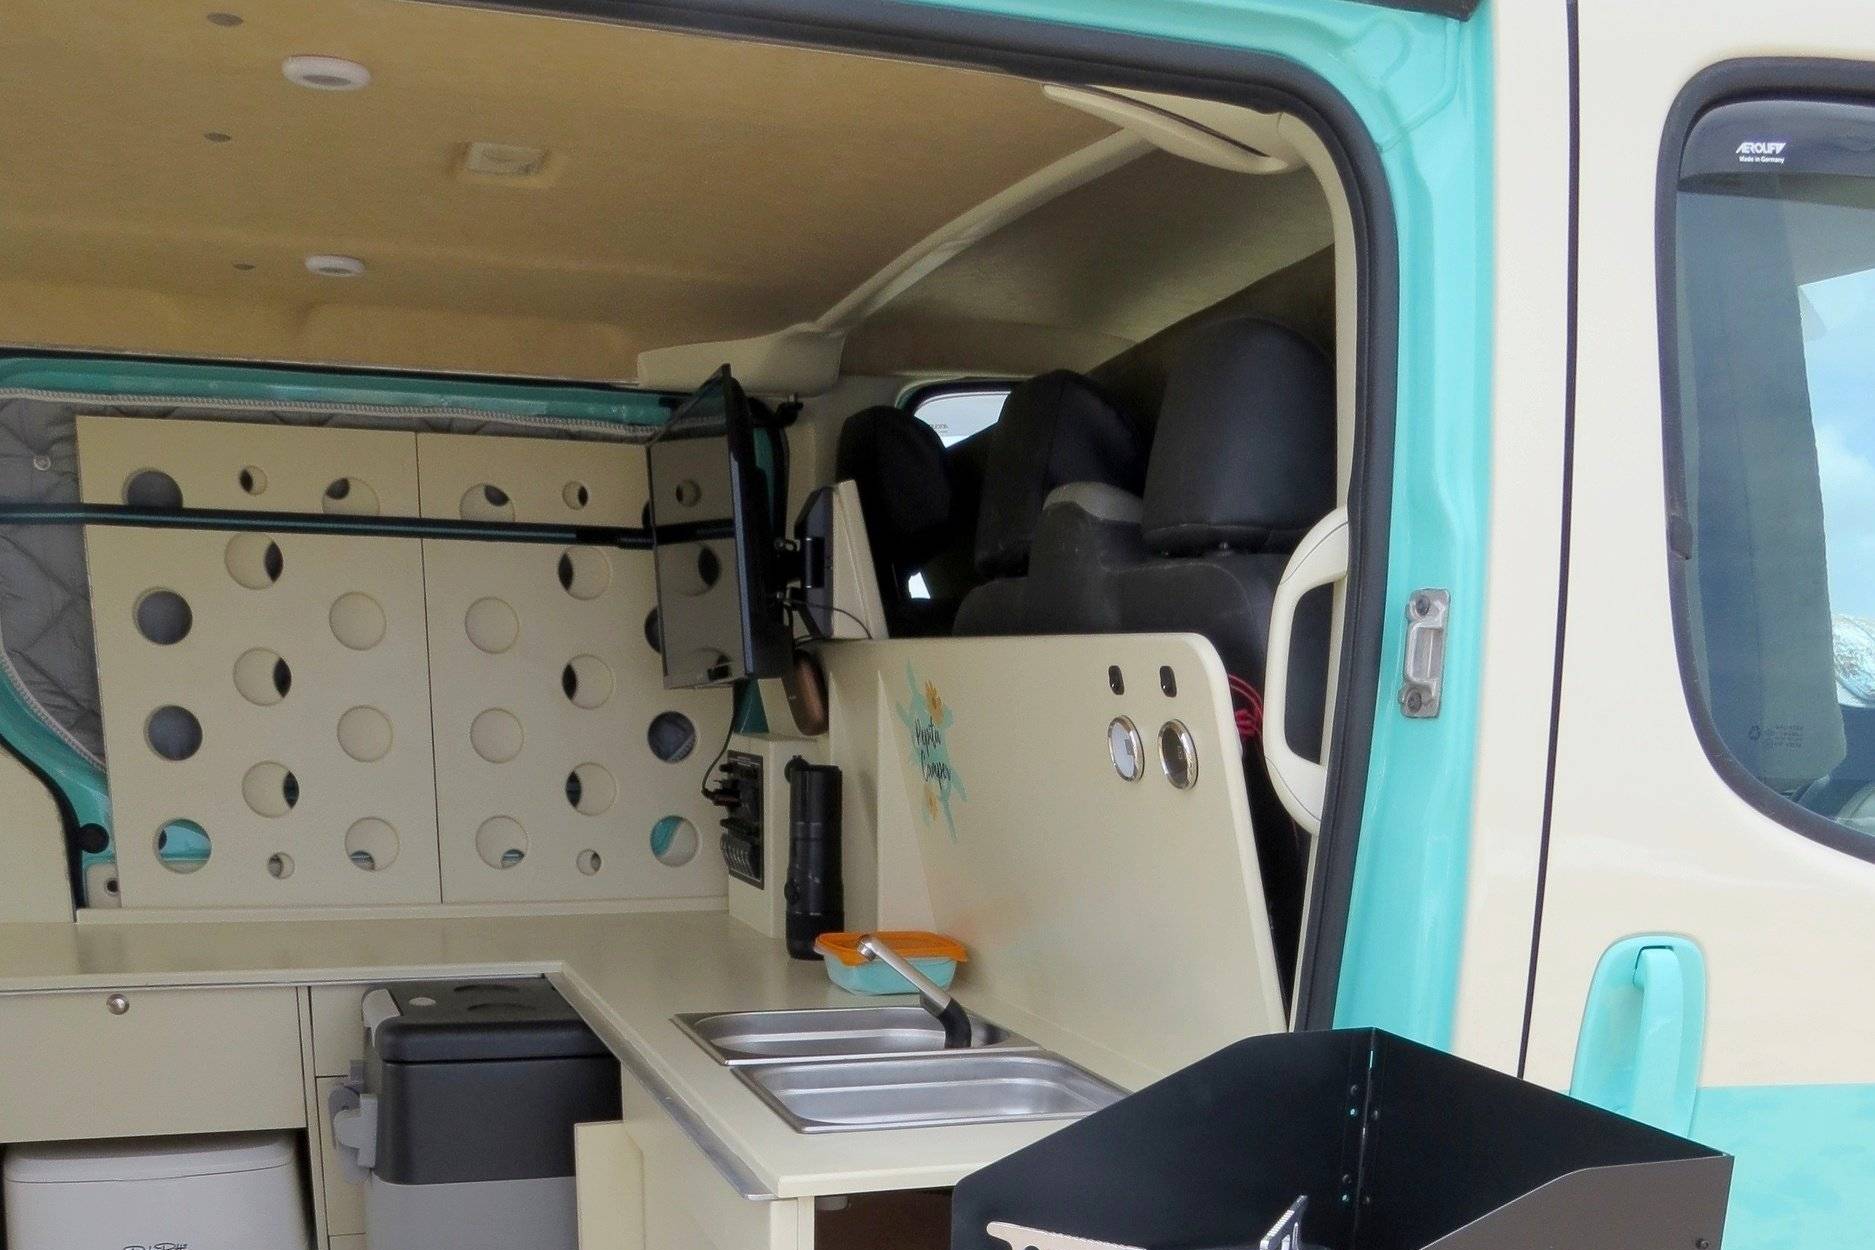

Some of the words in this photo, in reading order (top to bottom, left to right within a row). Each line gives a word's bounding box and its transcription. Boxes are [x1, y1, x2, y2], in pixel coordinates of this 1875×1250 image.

[1739, 155, 1754, 163] Made
[1755, 155, 1760, 163] in
[1761, 155, 1785, 164] Germany
